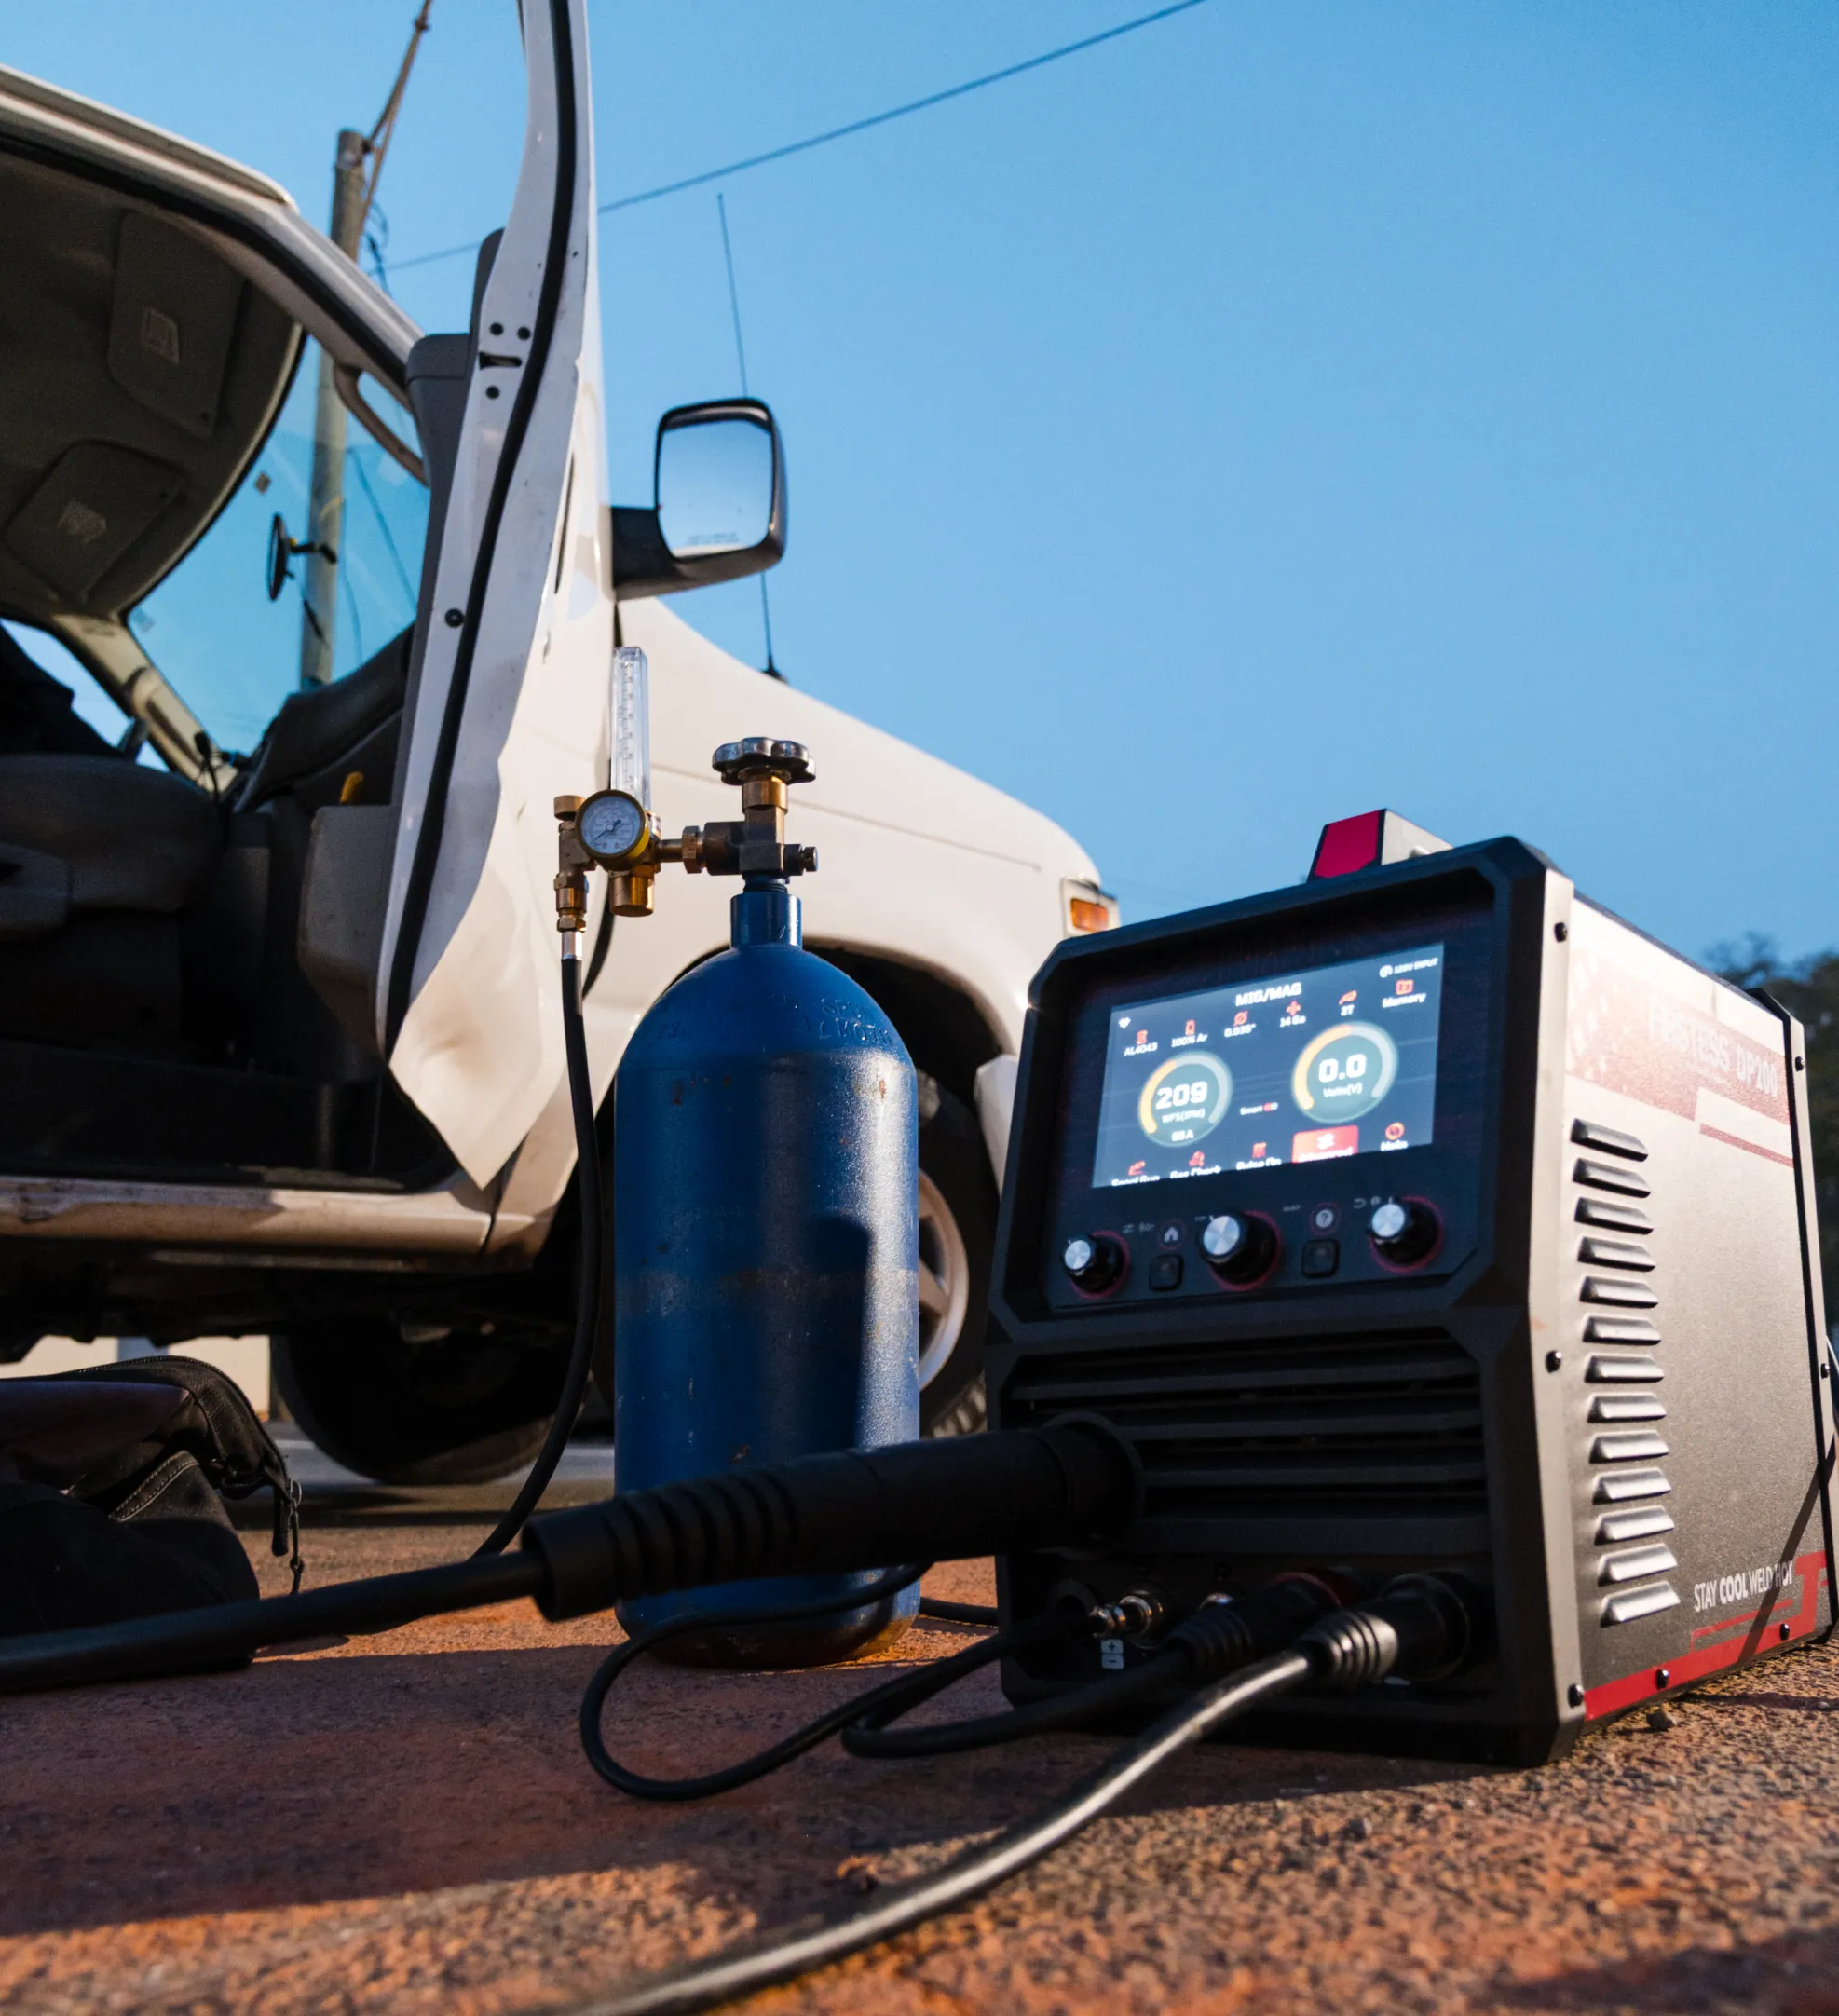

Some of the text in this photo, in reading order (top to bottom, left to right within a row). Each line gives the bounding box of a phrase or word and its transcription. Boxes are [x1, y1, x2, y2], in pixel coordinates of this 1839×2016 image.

[1414, 958, 1438, 971] INPUT
[1235, 982, 1302, 1006] MIG/MAG
[1382, 992, 1427, 1008] Memory
[1124, 1042, 1158, 1056] AL4043
[1171, 1033, 1208, 1048] 100% Ar
[1318, 1054, 1367, 1083] 0.0
[1155, 1081, 1208, 1110] 209
[1694, 1560, 1793, 1613] STAY COOL WELD HOT
